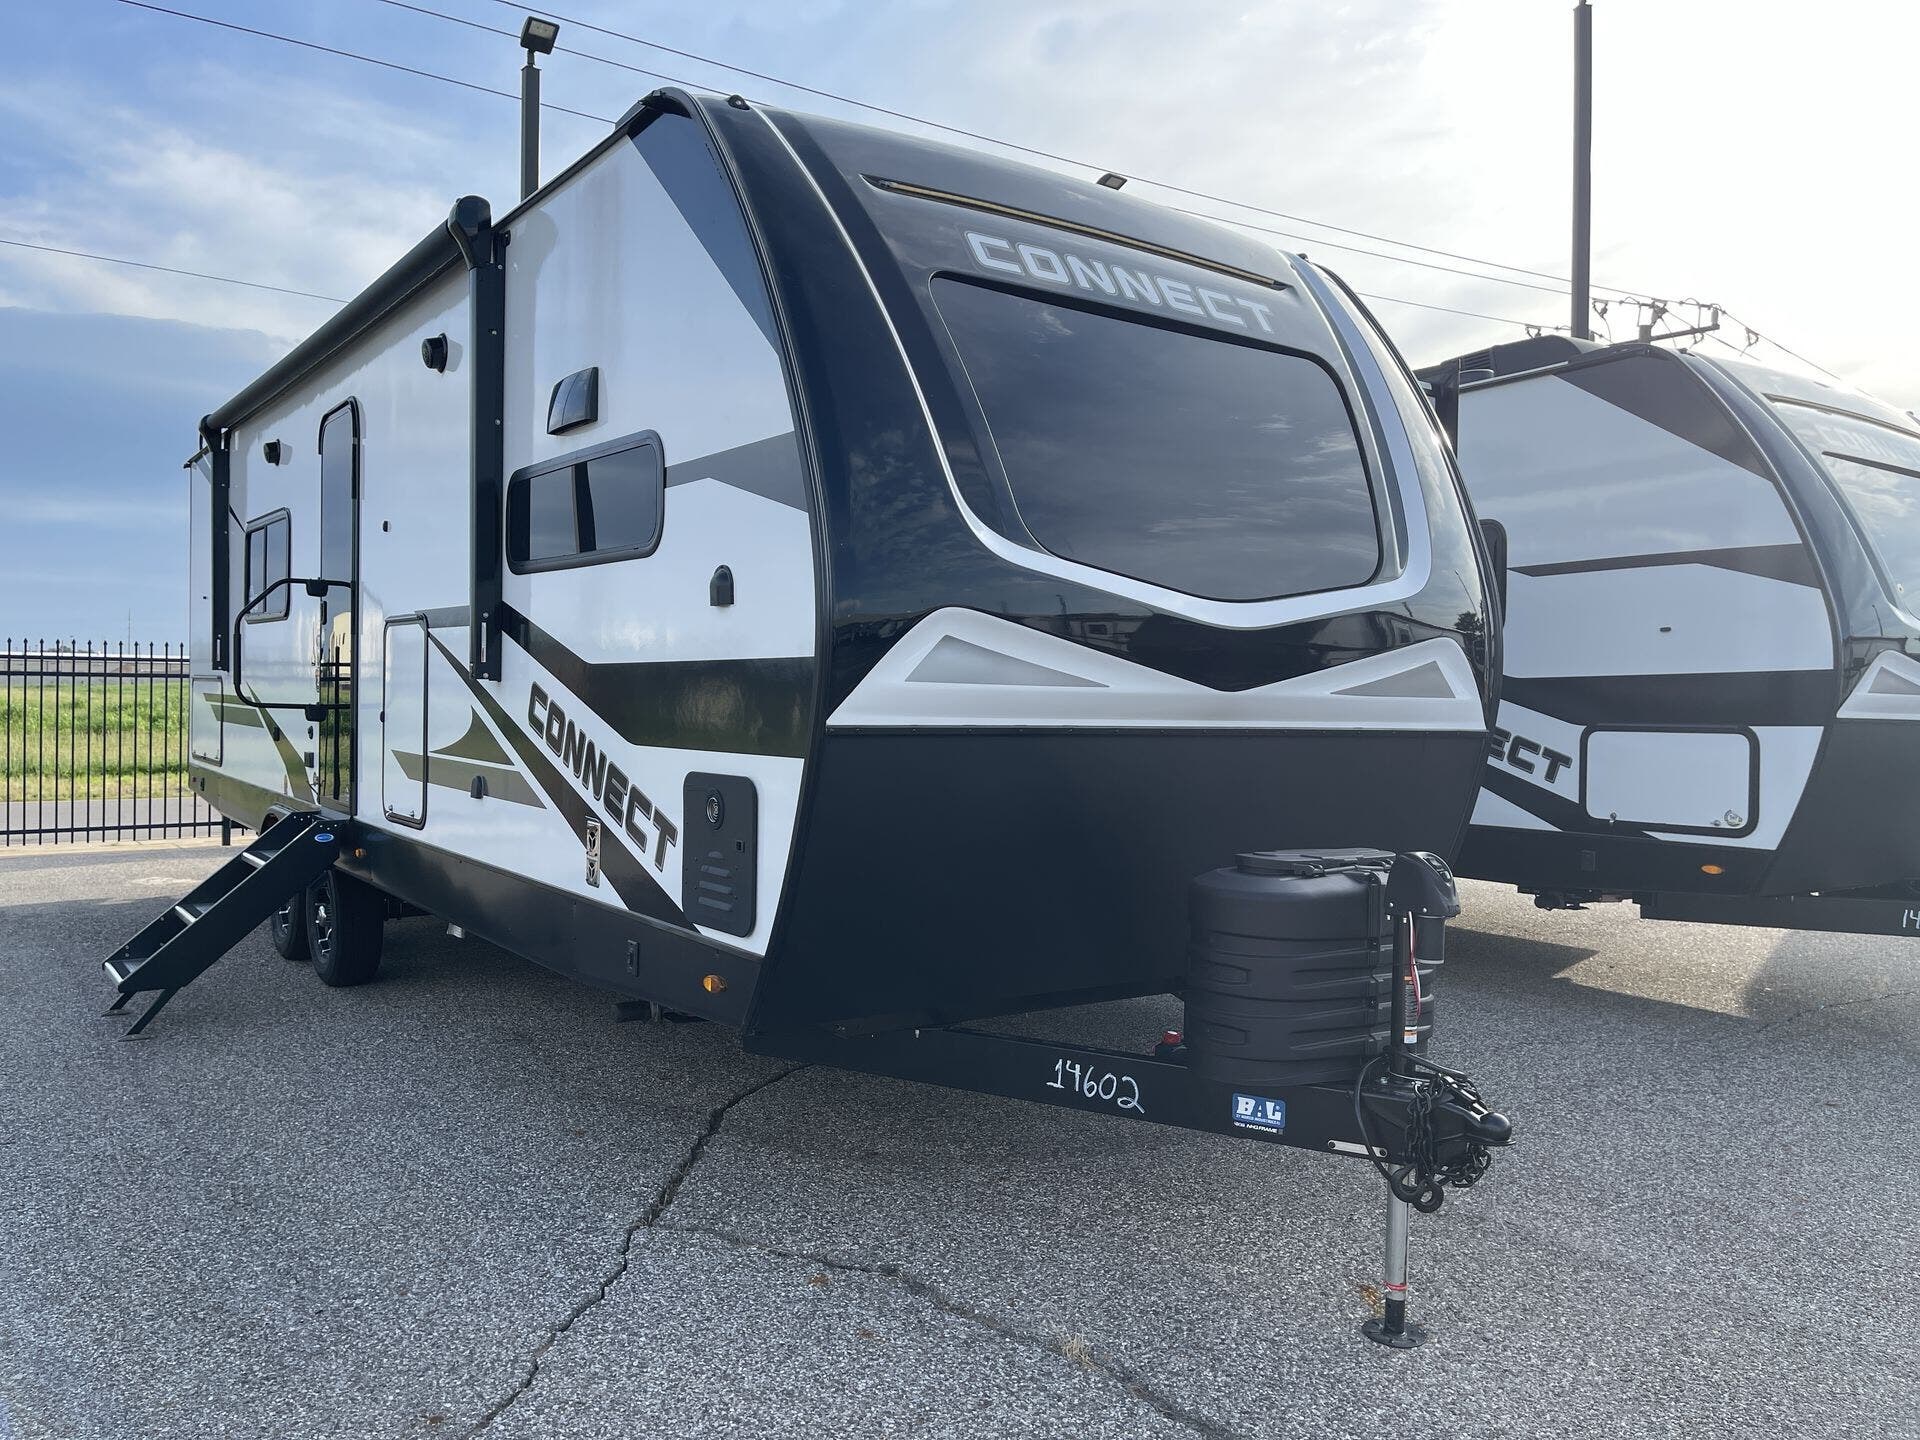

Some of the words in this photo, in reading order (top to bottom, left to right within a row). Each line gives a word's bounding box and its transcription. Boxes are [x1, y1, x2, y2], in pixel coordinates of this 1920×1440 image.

[966, 231, 1274, 334] CONNECT
[528, 681, 678, 872] CONNECT
[1046, 1059, 1145, 1113] 14602
[1236, 1096, 1282, 1121] BAL
